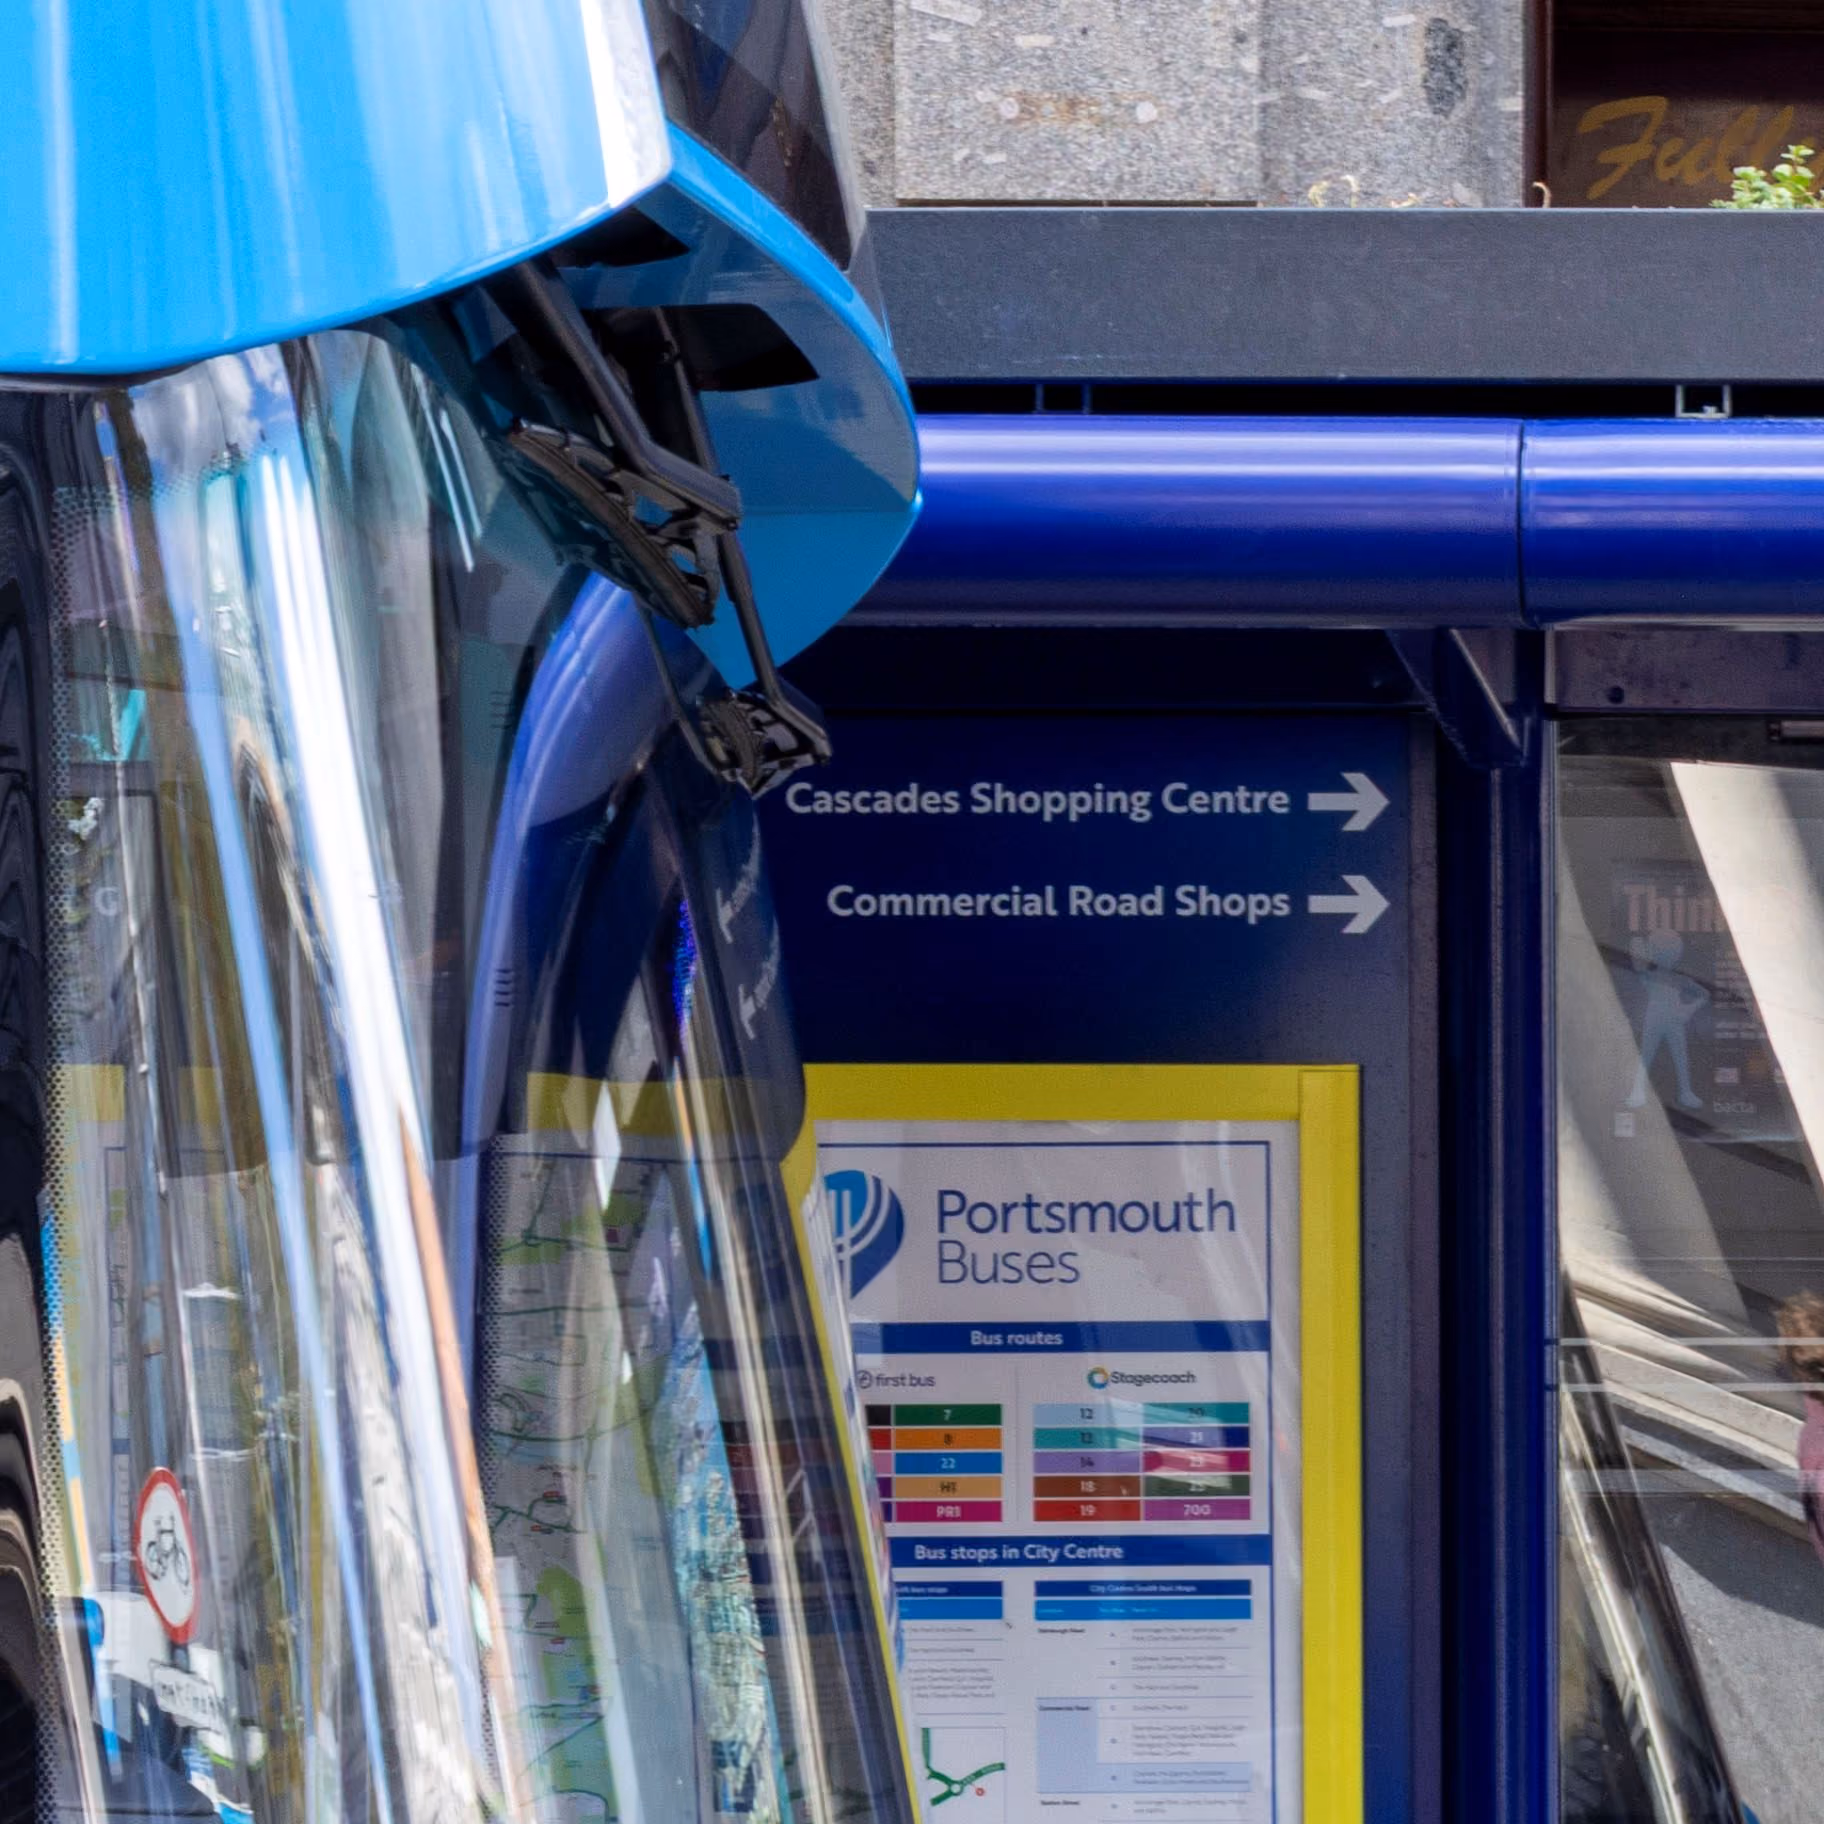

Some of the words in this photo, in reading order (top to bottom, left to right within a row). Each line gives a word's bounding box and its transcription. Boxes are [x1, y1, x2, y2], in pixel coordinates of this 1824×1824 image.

[786, 782, 959, 816] Cascades
[970, 782, 1151, 822] Shopping
[1162, 783, 1290, 816] Centre
[827, 885, 1057, 917] Commercial
[1069, 885, 1164, 917] Road
[1176, 885, 1290, 925] Shops
[937, 1188, 1236, 1235] Portsmouth
[938, 1242, 1080, 1285] Buses
[971, 1330, 1003, 1346] Bus
[1008, 1331, 1063, 1346] routes
[1111, 1371, 1196, 1387] Stagecoach
[915, 1545, 946, 1559] Bus
[951, 1545, 997, 1562] stops
[1003, 1544, 1020, 1559] in
[1024, 1544, 1059, 1562] City
[1064, 1544, 1123, 1559] Centre
